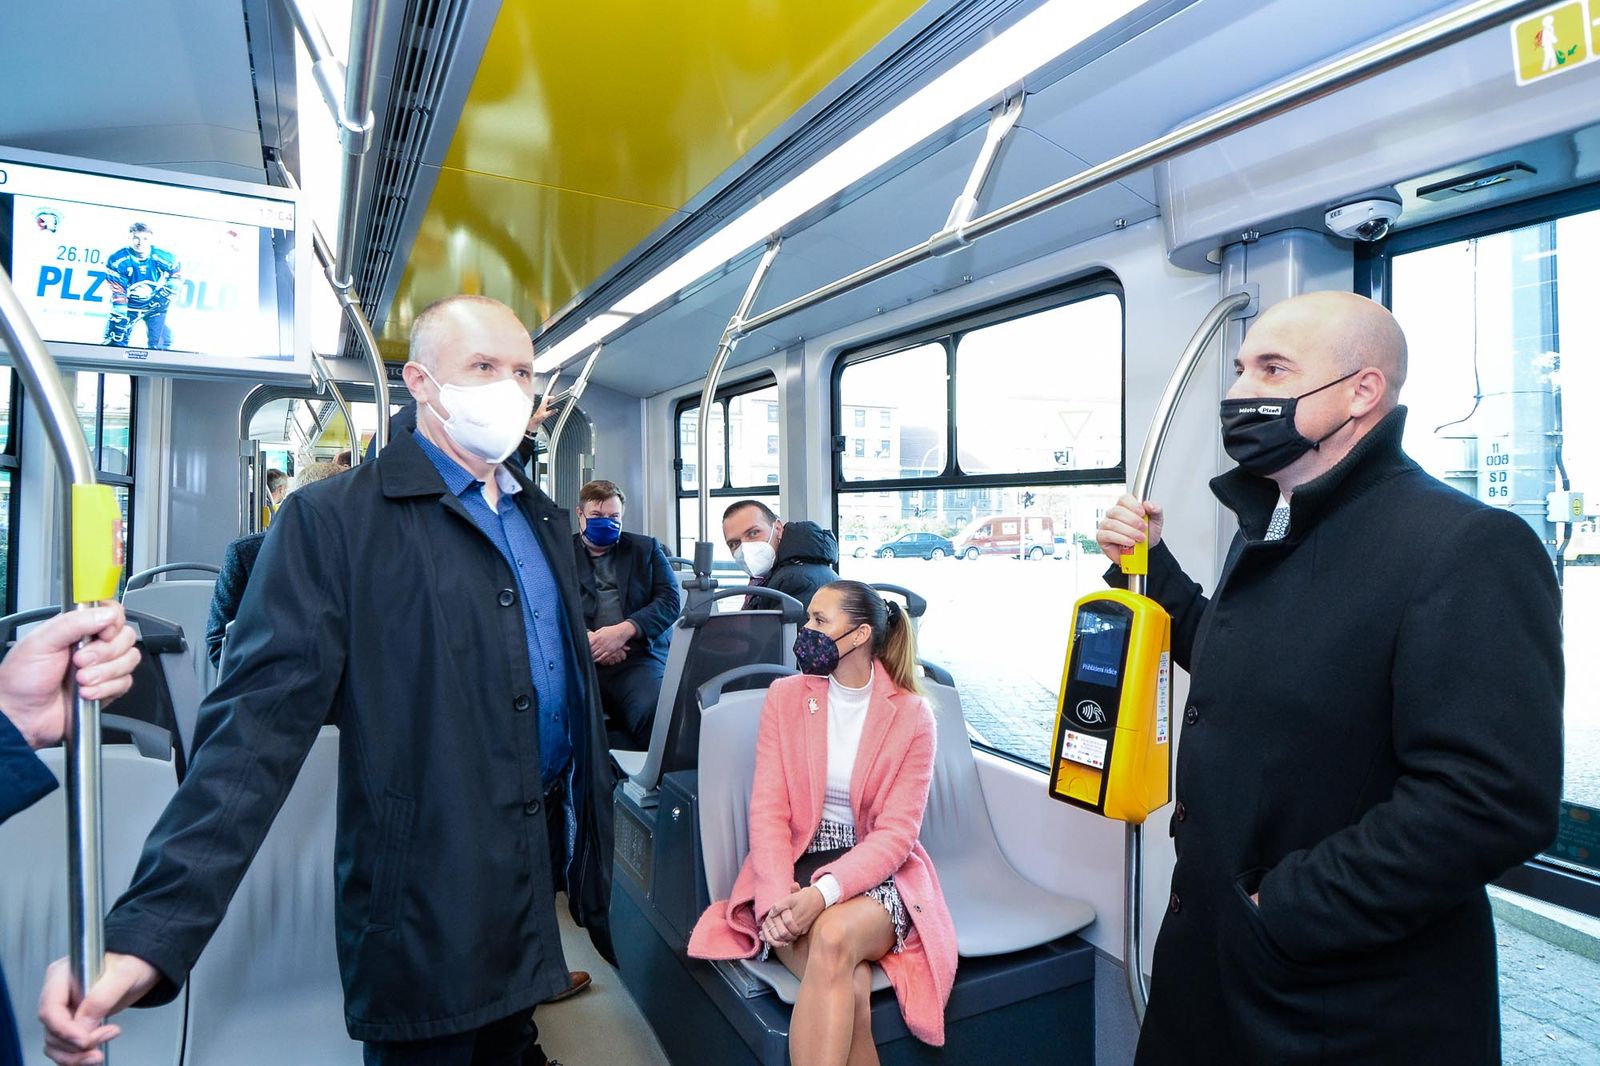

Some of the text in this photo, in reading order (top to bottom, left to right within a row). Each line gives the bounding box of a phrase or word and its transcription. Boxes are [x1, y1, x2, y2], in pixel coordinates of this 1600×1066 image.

[56, 245, 104, 265] 26.10.
[37, 265, 107, 302] PLZ
[1486, 454, 1508, 465] 008
[1488, 486, 1508, 497] 8-6
